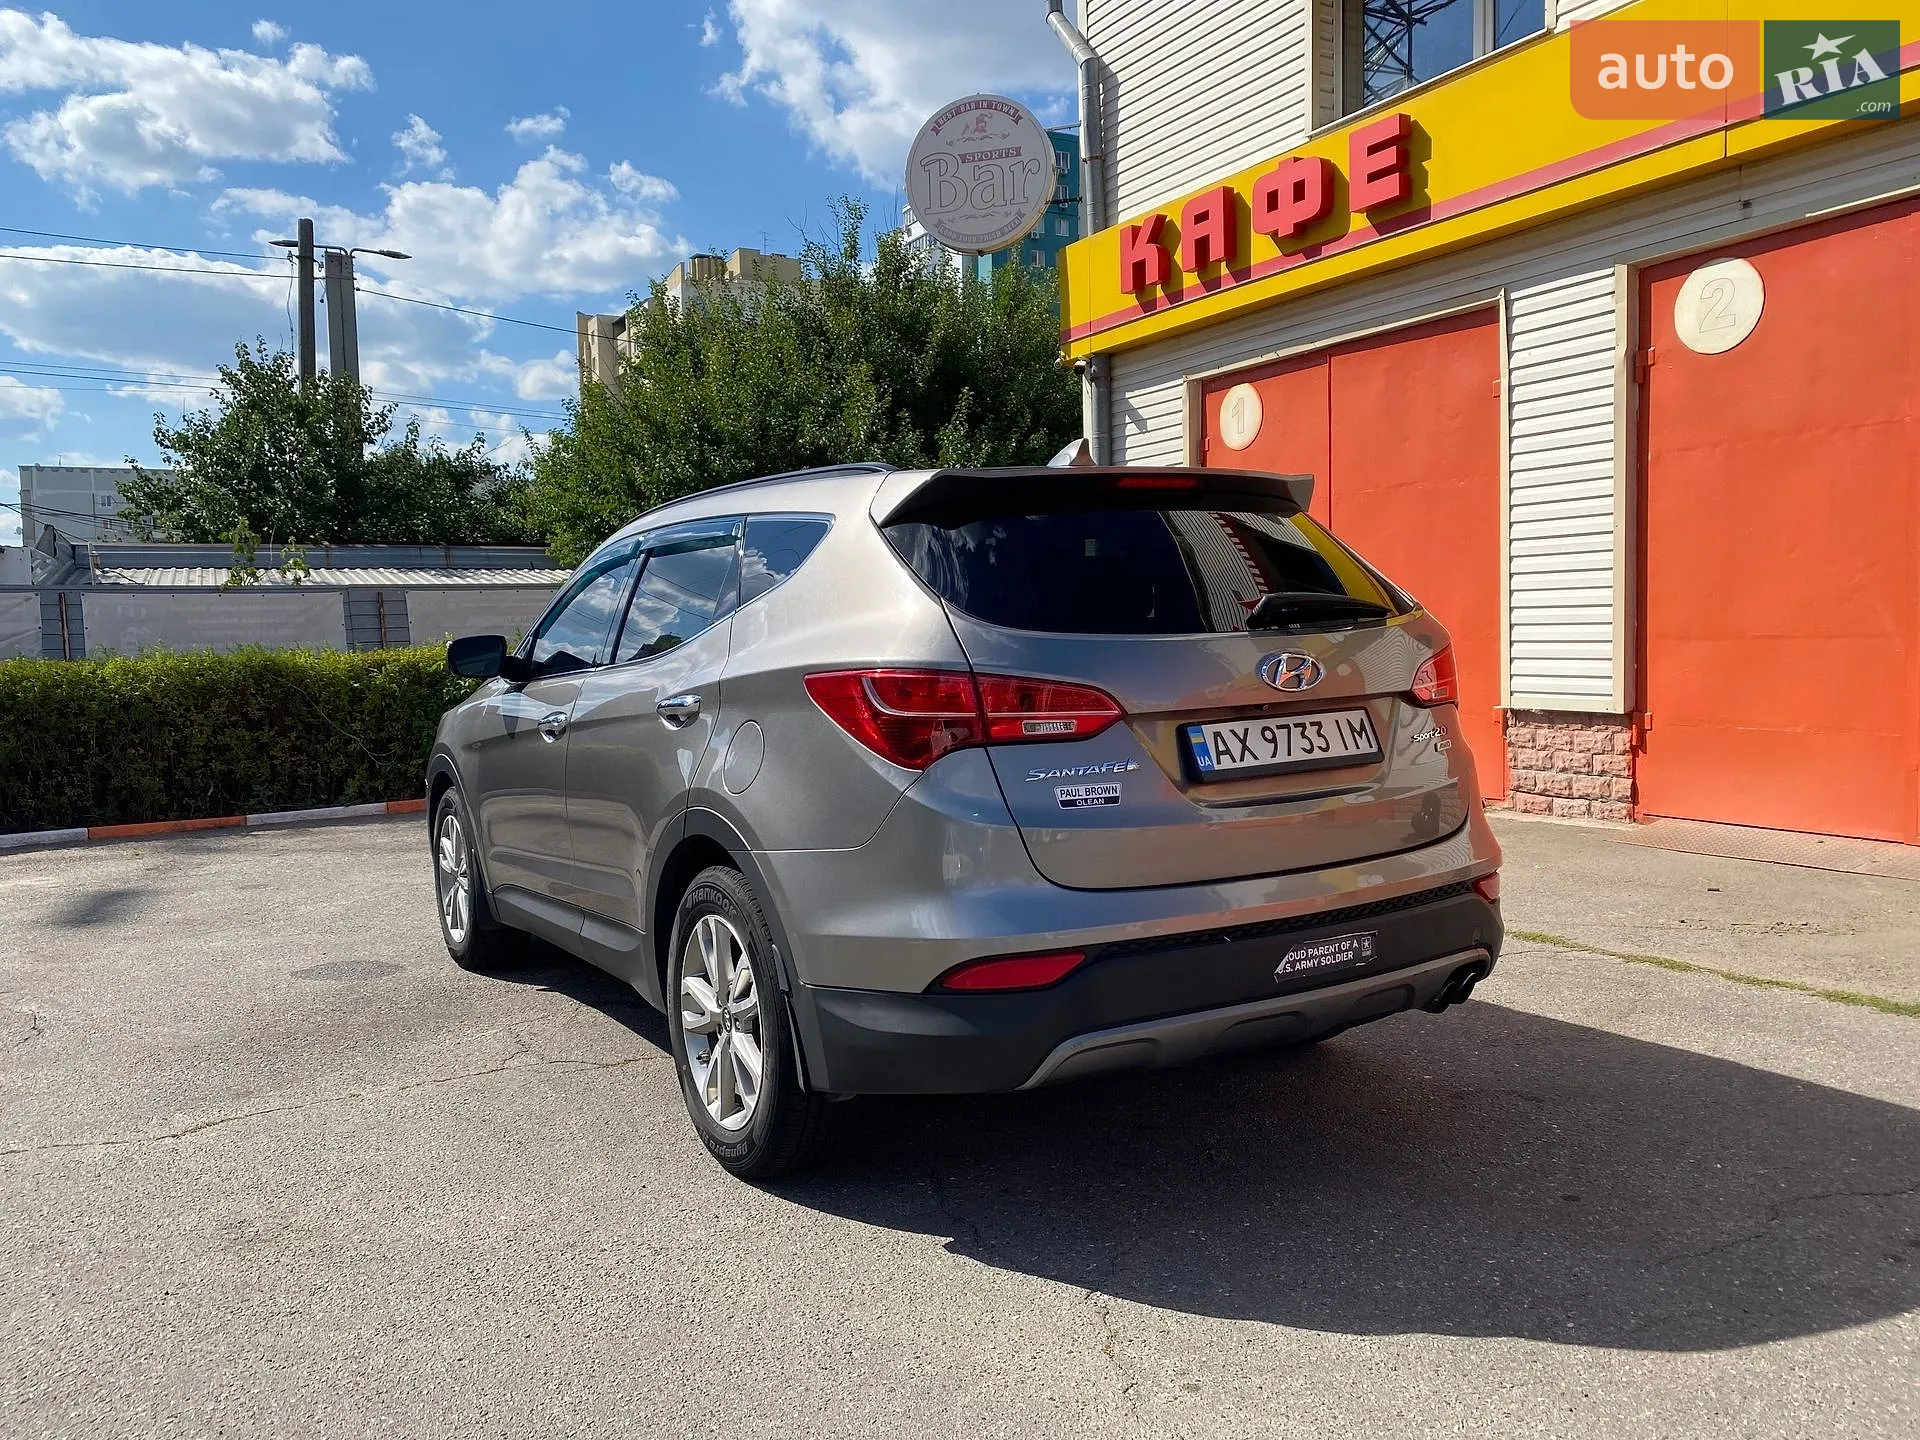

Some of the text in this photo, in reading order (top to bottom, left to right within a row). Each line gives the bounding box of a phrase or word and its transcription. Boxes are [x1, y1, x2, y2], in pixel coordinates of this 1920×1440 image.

[939, 110, 957, 124] BEST
[979, 100, 988, 108] IN
[992, 101, 1016, 116] TOWN
[965, 147, 1017, 162] SPORTS
[919, 152, 1041, 216] Bar
[1120, 113, 1411, 294] КАФЕ
[1699, 277, 1736, 334] 2
[1231, 397, 1245, 434] 1
[1212, 717, 1374, 765] AX 9733 IM
[1413, 731, 1435, 742] Sport
[1198, 756, 1213, 768] UA
[1060, 785, 1118, 798] PAUL BROWN
[1076, 798, 1105, 806] OLEAN
[1286, 939, 1359, 962] OUD PARENT OF A
[1295, 958, 1320, 971] ARMY
[1320, 951, 1354, 966] SOLDIER
